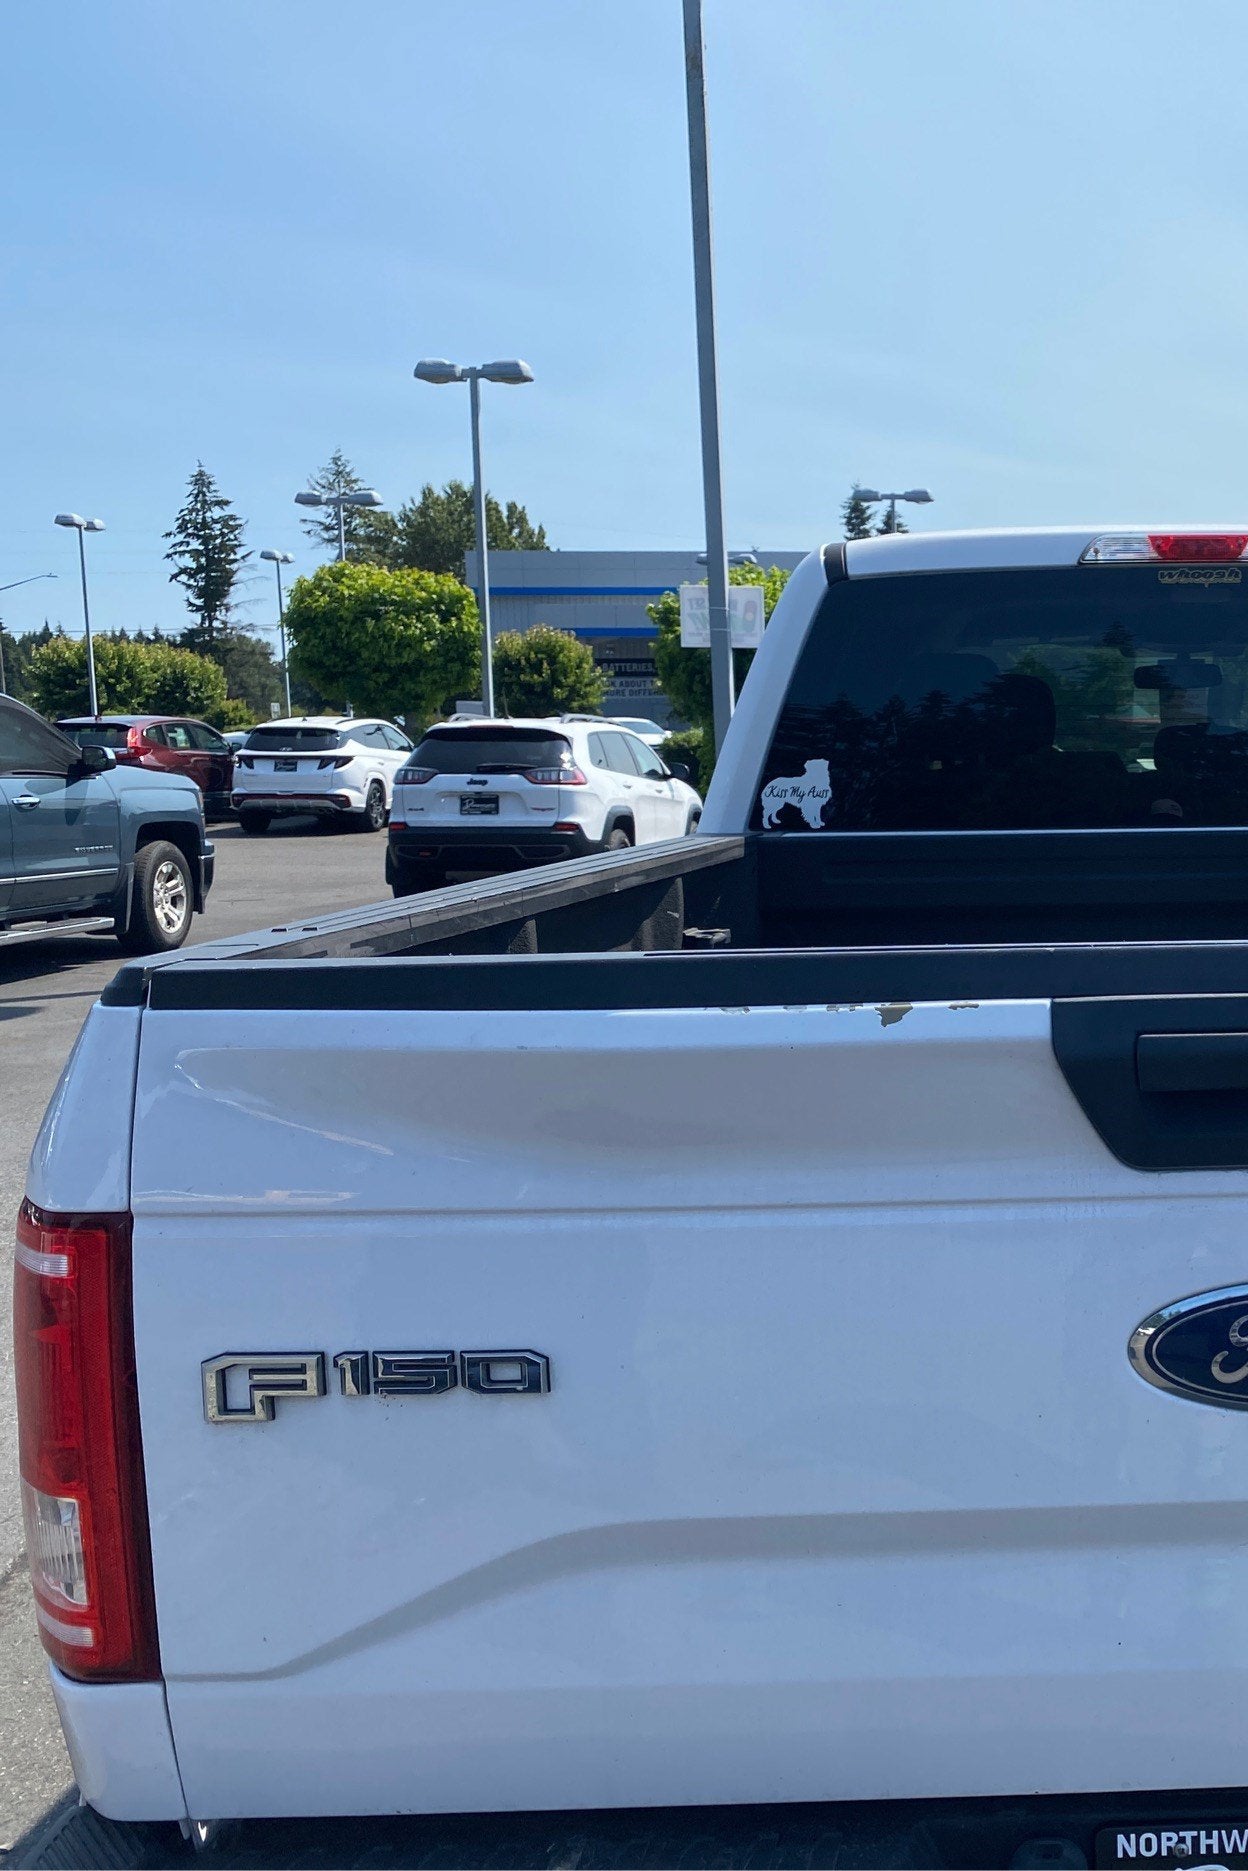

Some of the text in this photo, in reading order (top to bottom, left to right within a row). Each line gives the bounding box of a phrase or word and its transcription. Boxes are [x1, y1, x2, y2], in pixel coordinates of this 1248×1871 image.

[1159, 567, 1242, 580] whoosh
[765, 786, 788, 798] Kiss
[790, 786, 806, 803] My
